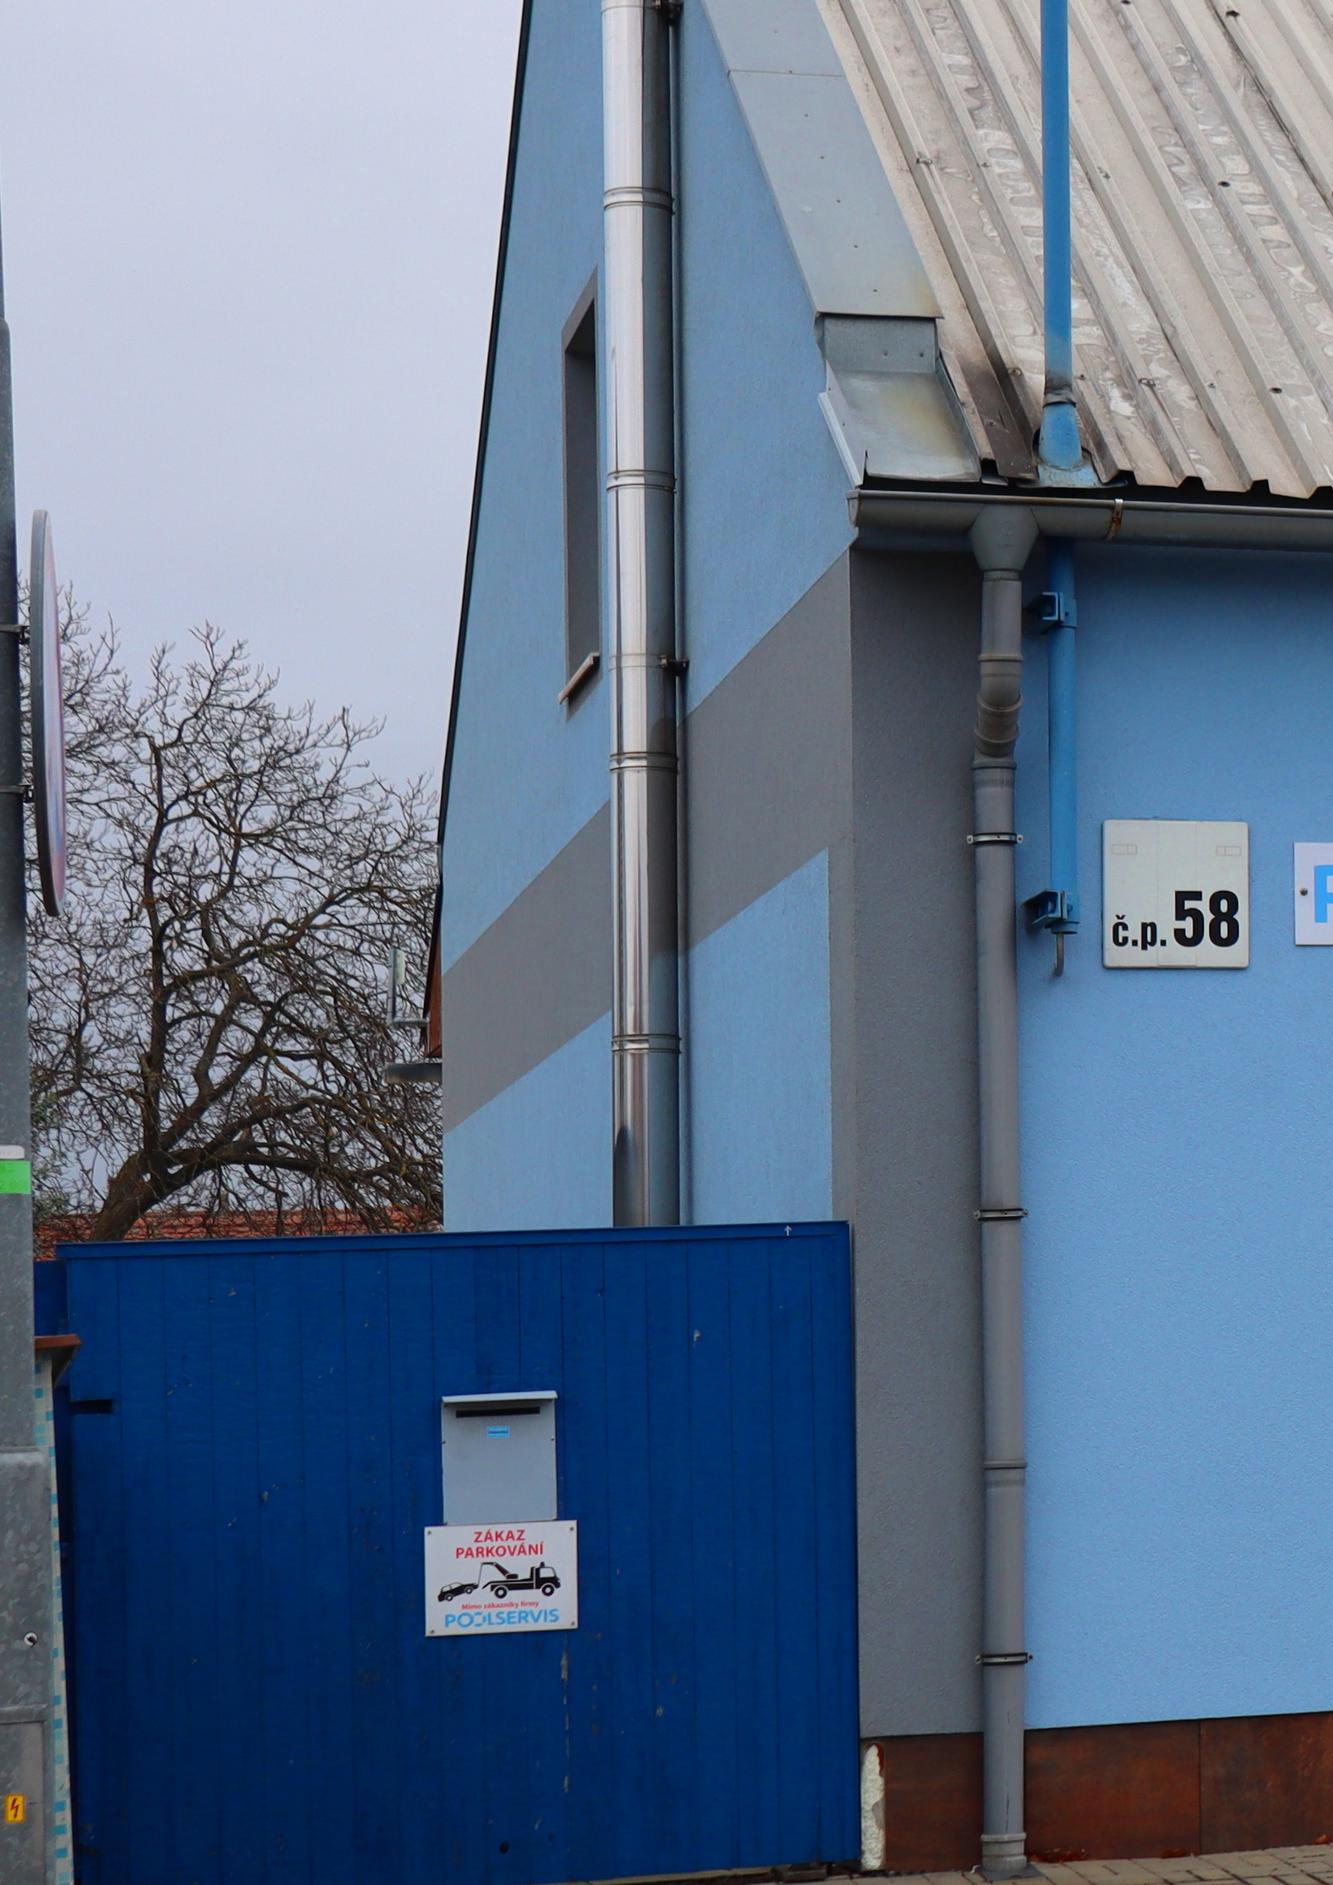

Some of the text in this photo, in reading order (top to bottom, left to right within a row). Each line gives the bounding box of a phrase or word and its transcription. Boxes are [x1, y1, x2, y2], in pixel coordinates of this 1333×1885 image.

[1112, 890, 1240, 951] č.p. 58
[474, 1529, 525, 1543] ZÁKAZ
[456, 1542, 544, 1559] PARKOVÁNÍ
[444, 1608, 559, 1628] POOLSERVIS
